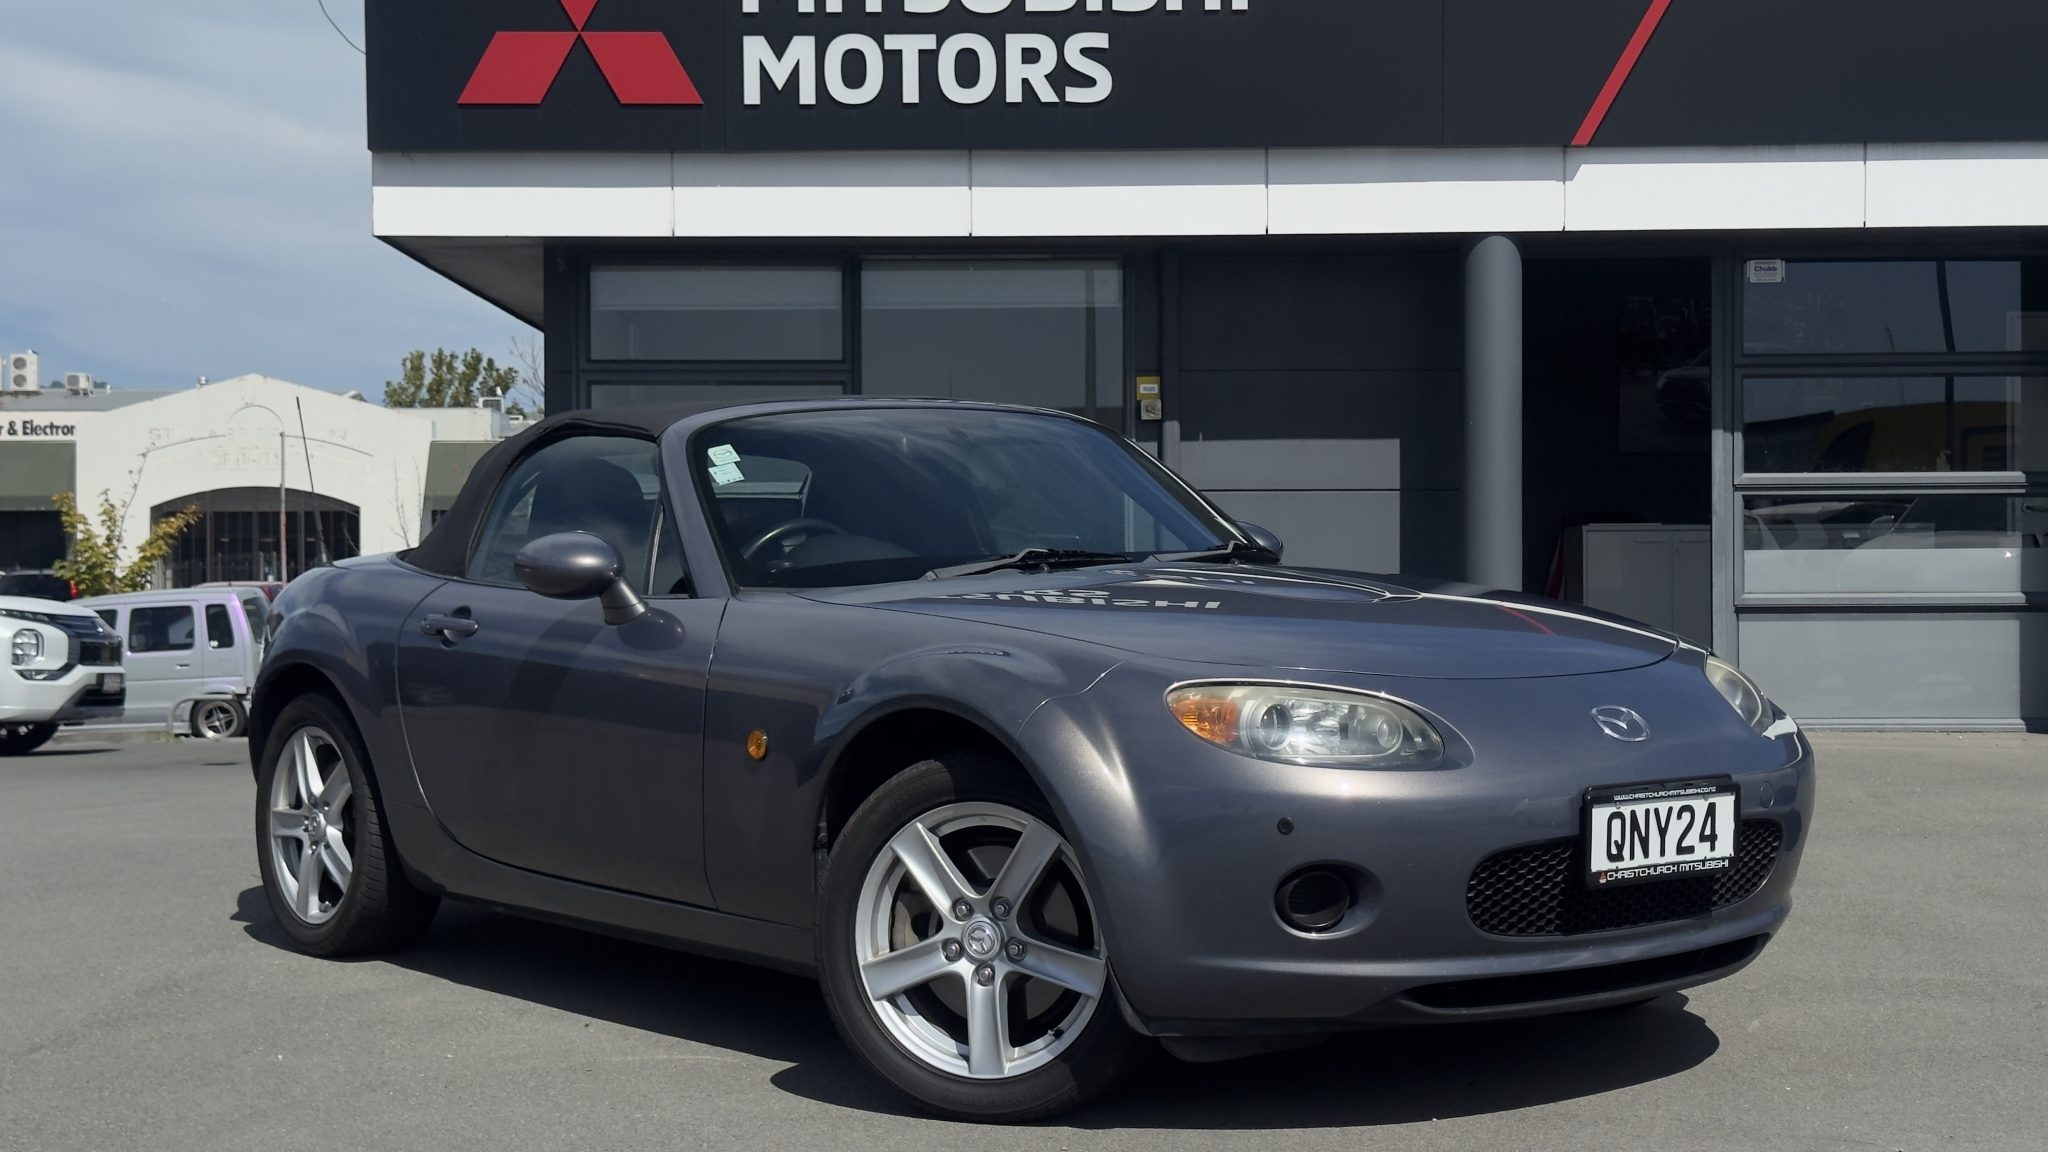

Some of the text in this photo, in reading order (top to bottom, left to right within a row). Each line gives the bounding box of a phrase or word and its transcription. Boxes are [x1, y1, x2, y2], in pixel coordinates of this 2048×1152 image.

[743, 32, 1112, 104] MOTORS
[7, 420, 18, 436] &
[1606, 801, 1718, 863] QNY24
[1607, 858, 1729, 881] CHRISTCHURCH MITSUBISHI
